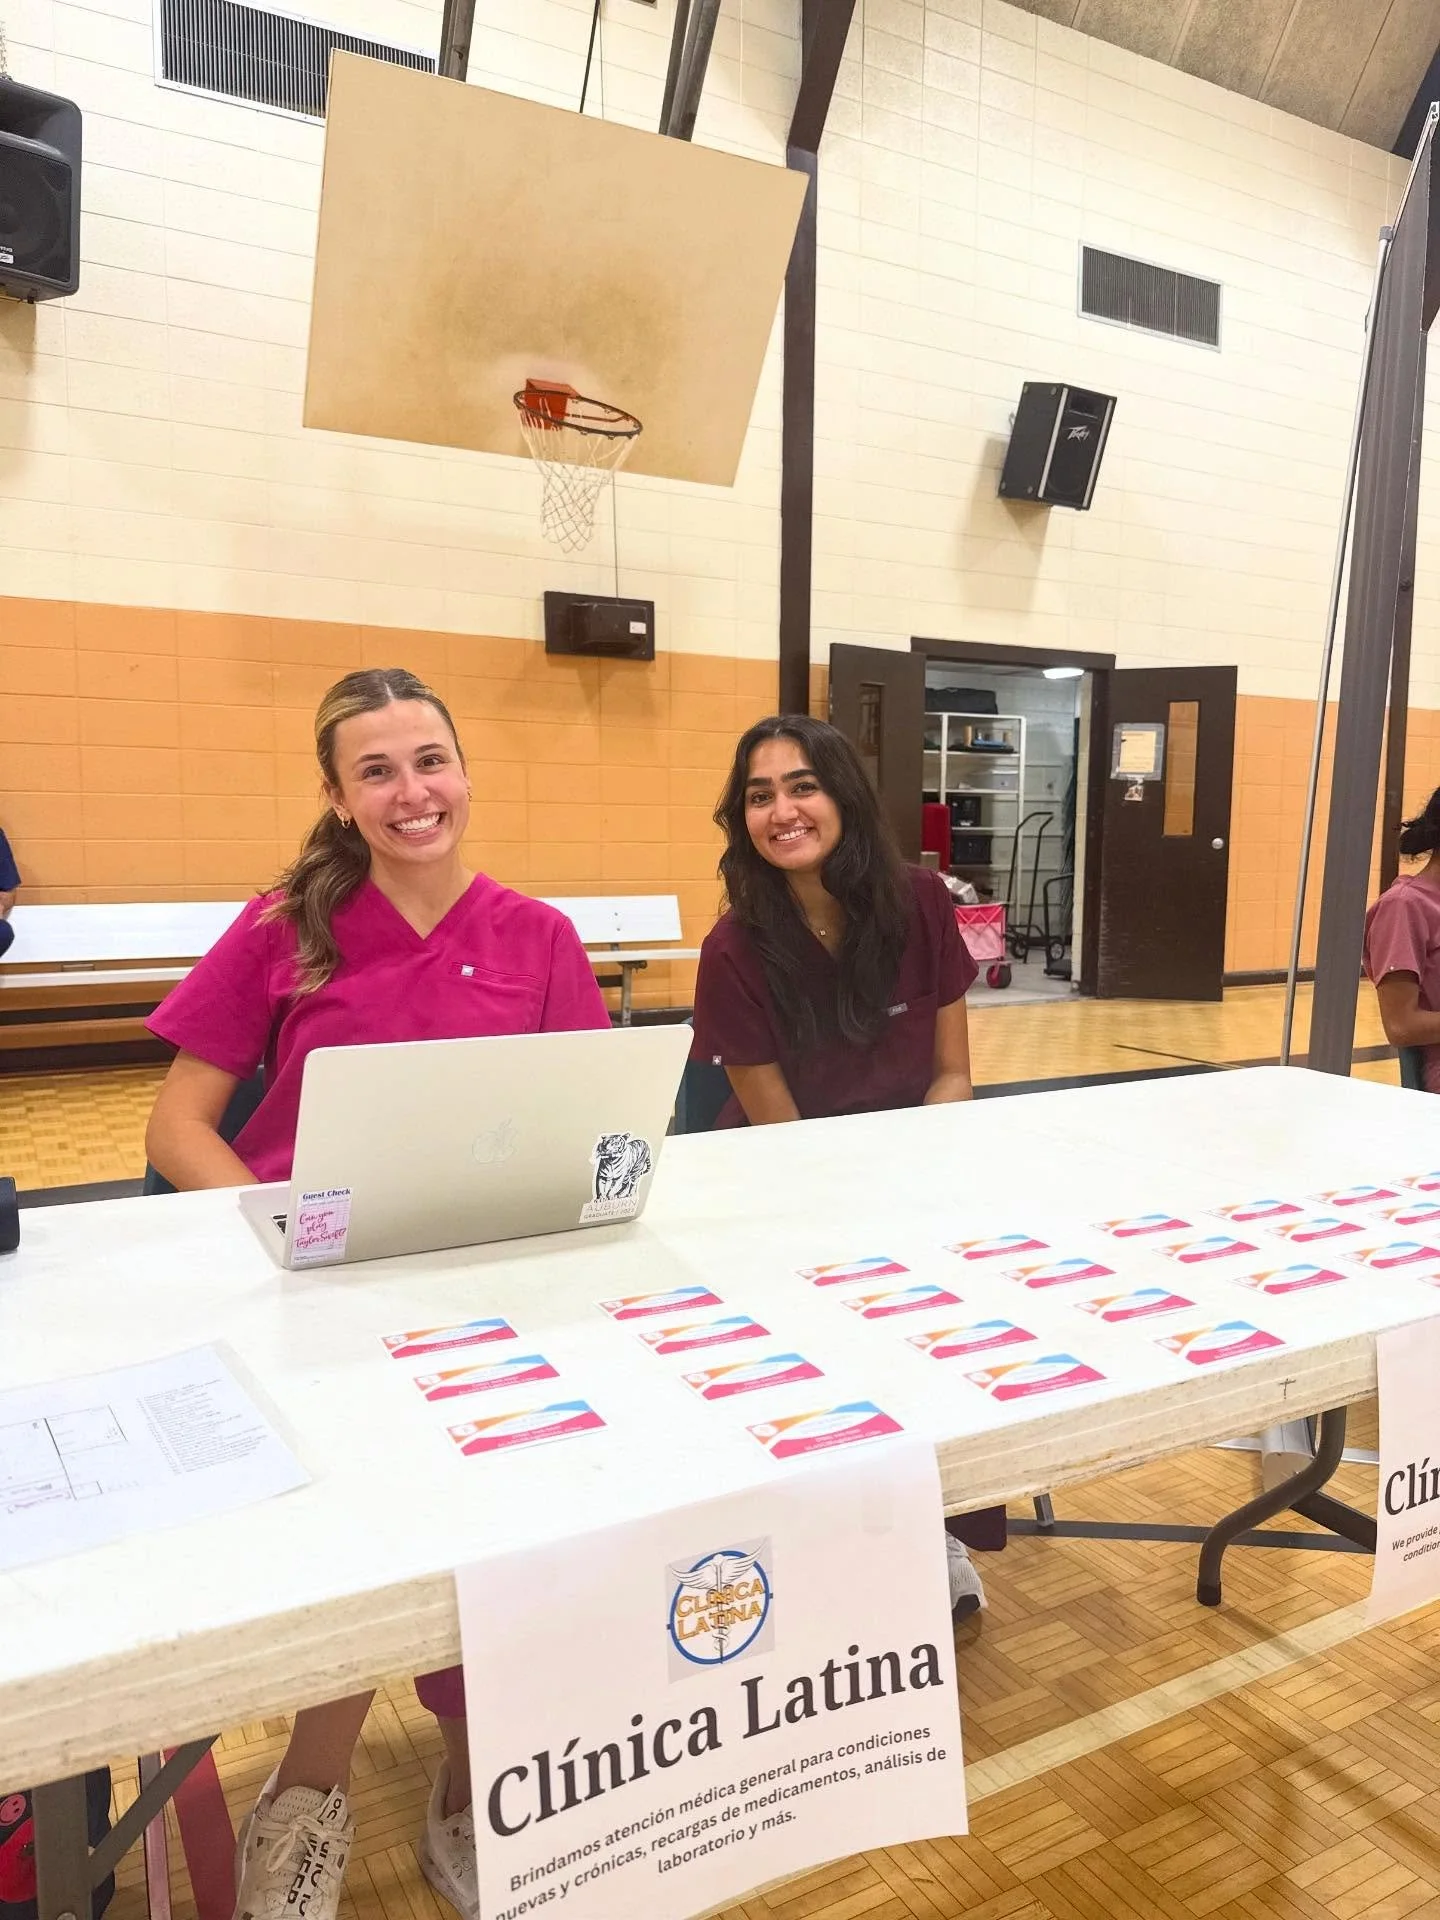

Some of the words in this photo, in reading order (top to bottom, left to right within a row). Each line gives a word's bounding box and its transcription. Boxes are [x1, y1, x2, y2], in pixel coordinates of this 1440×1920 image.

[303, 1192, 324, 1200] Guest
[327, 1189, 350, 1197] Check
[1392, 1539, 1405, 1551] We
[1405, 1526, 1438, 1548] provide
[487, 1704, 723, 1838] Clínica
[740, 1642, 944, 1740] Latina
[510, 1839, 601, 1892] Brindamos
[604, 1806, 675, 1847] atención
[679, 1783, 736, 1815] médica
[739, 1759, 797, 1794] general
[800, 1749, 834, 1773] para
[837, 1727, 931, 1758] condiciones
[560, 1880, 570, 1898] y
[574, 1845, 648, 1887] crónicas,
[651, 1814, 718, 1852] recargas
[721, 1804, 741, 1827] de
[744, 1766, 861, 1813] medicamentos,
[864, 1750, 923, 1775] análisis
[926, 1746, 947, 1763] de
[657, 1825, 746, 1874] laboratorio
[748, 1822, 758, 1840] y
[761, 1810, 797, 1831] más.
